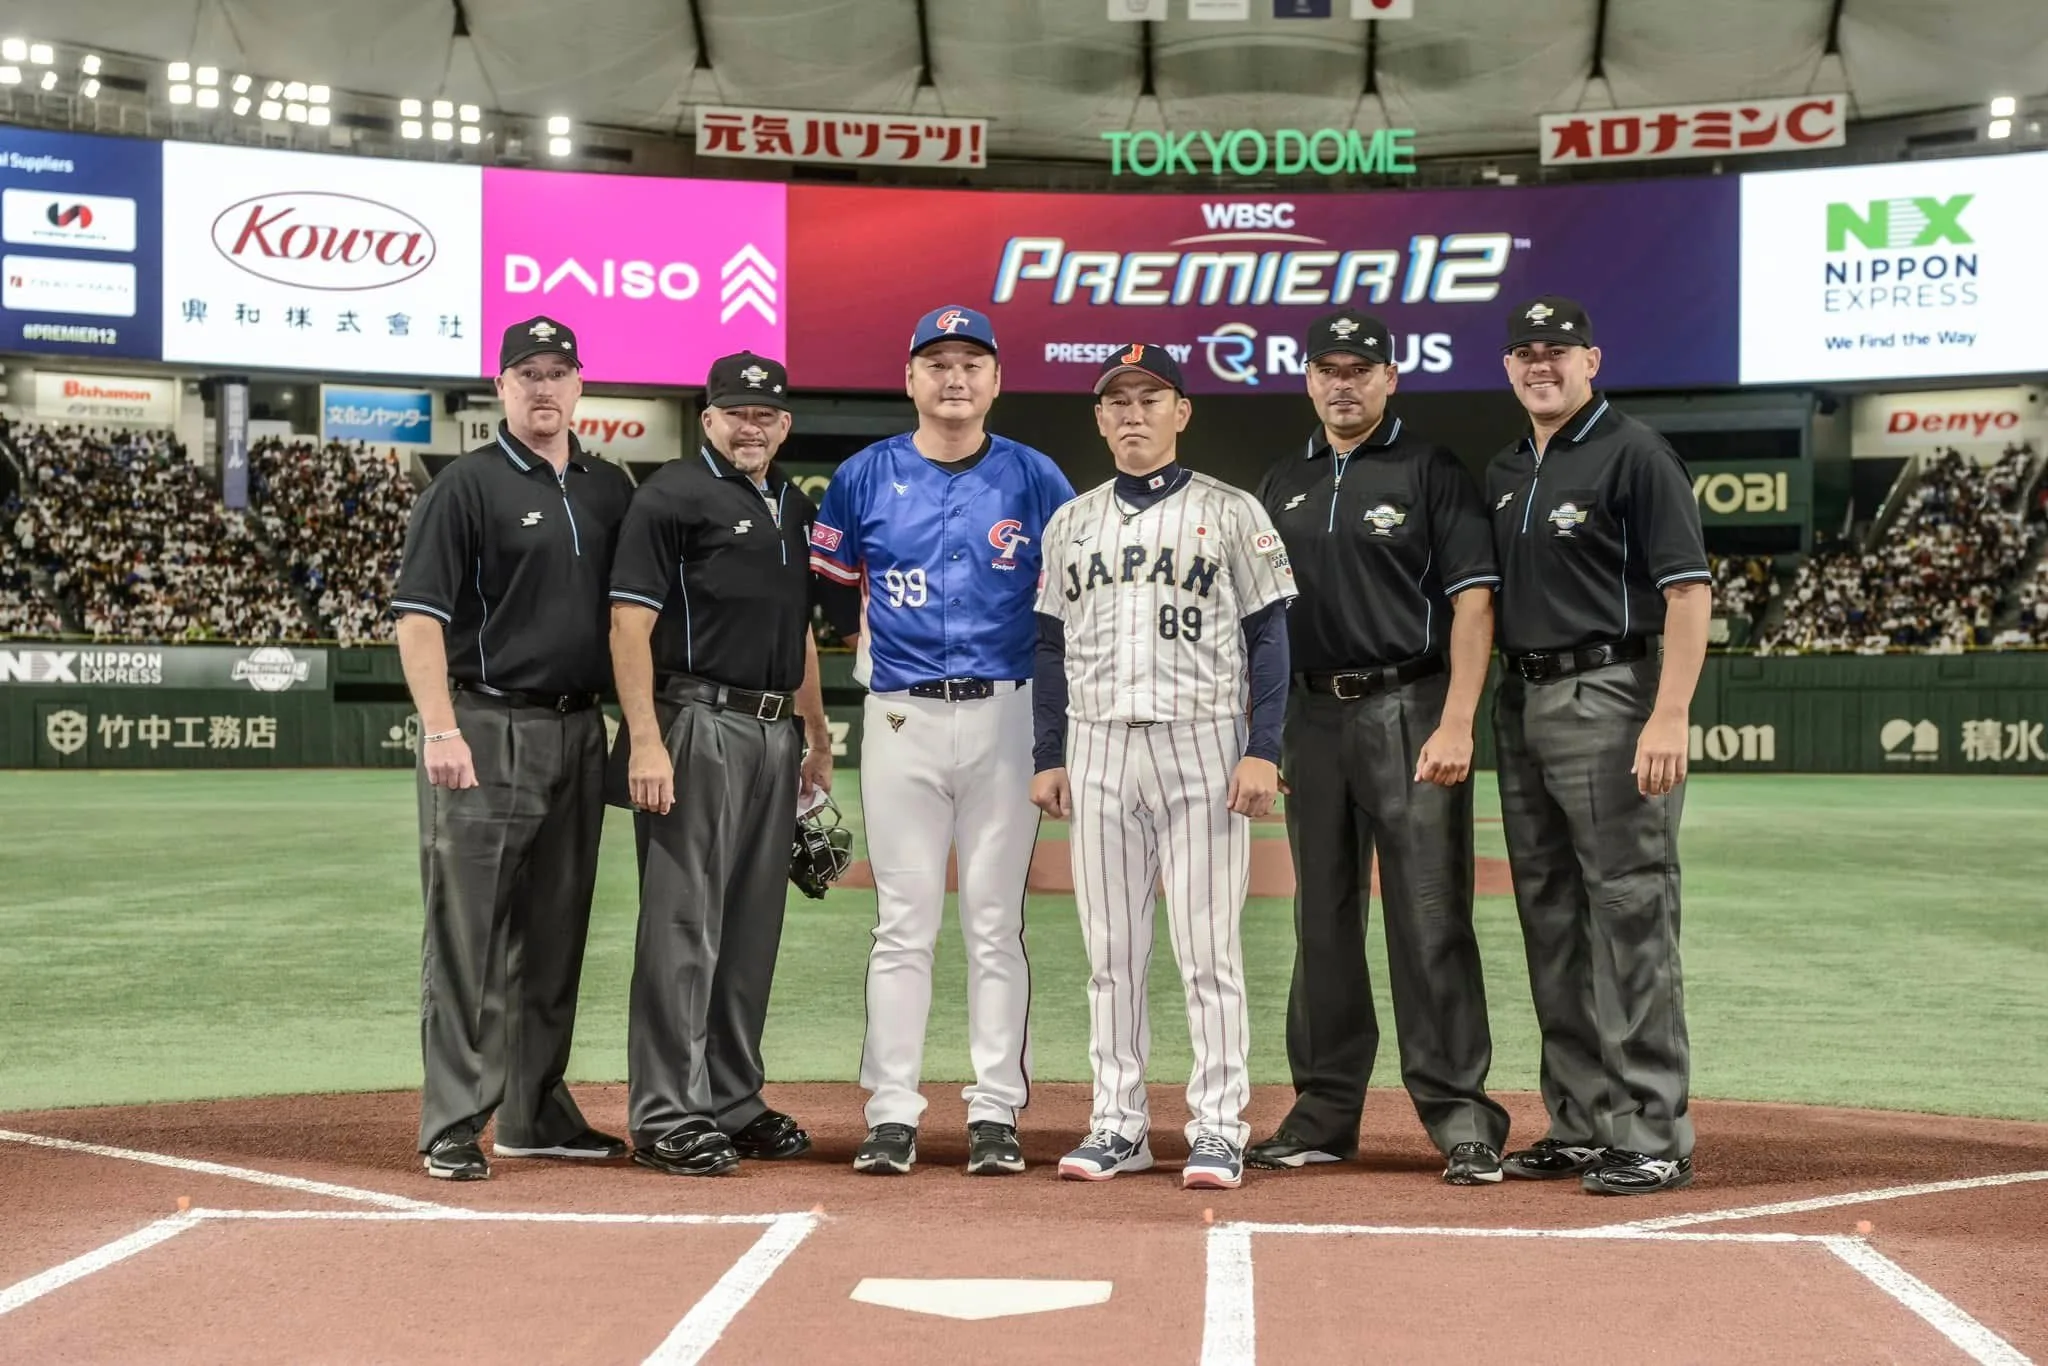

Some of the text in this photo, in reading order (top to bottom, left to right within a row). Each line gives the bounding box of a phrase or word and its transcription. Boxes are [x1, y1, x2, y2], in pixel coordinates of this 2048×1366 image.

[702, 113, 981, 164] 元気ハツラツ!
[1552, 100, 1835, 160] オロナミンC
[10, 152, 74, 173] Suppliers
[1101, 129, 1417, 176] TOKYO DOME
[1201, 203, 1295, 230] WBSC
[1826, 194, 1976, 252] NX
[232, 205, 426, 267] Kowa
[504, 254, 699, 300] DAISO
[1825, 254, 1978, 285] NIPPON
[1825, 281, 1978, 312] EXPRESS
[1266, 332, 1452, 375] RUS
[1825, 330, 1977, 351] We Find the Way
[471, 422, 489, 439] 16
[568, 417, 645, 443] nyo
[1887, 409, 2019, 436] Denyo
[885, 569, 928, 607] 99
[1065, 546, 1219, 602] JAPAN
[1159, 605, 1203, 642] 89
[0, 650, 77, 683] NX
[80, 652, 162, 668] NIPPON
[80, 668, 162, 684] EXPRESS
[97, 714, 278, 750] 竹中工務店
